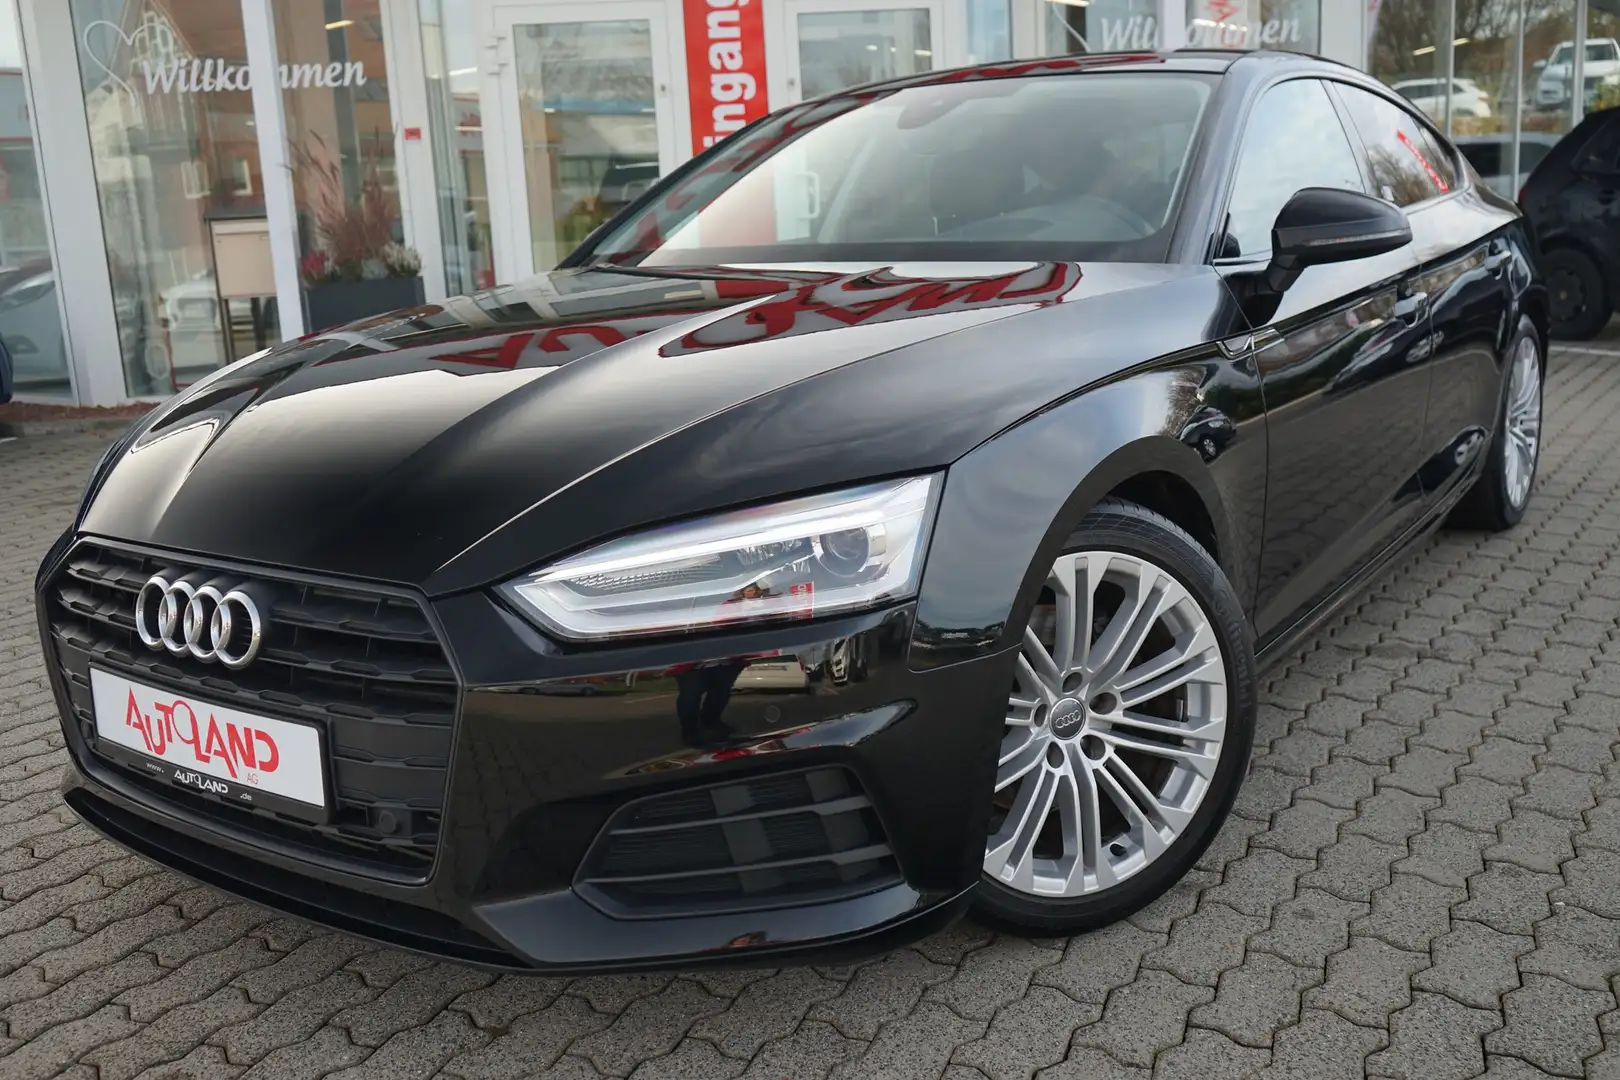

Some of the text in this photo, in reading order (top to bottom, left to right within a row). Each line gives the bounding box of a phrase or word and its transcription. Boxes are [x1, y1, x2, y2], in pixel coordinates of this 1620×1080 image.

[1101, 16, 1300, 51] Willommen
[703, 0, 757, 149] ngan
[145, 762, 165, 774] www.
[240, 792, 252, 801] .de
[246, 772, 259, 785] AG
